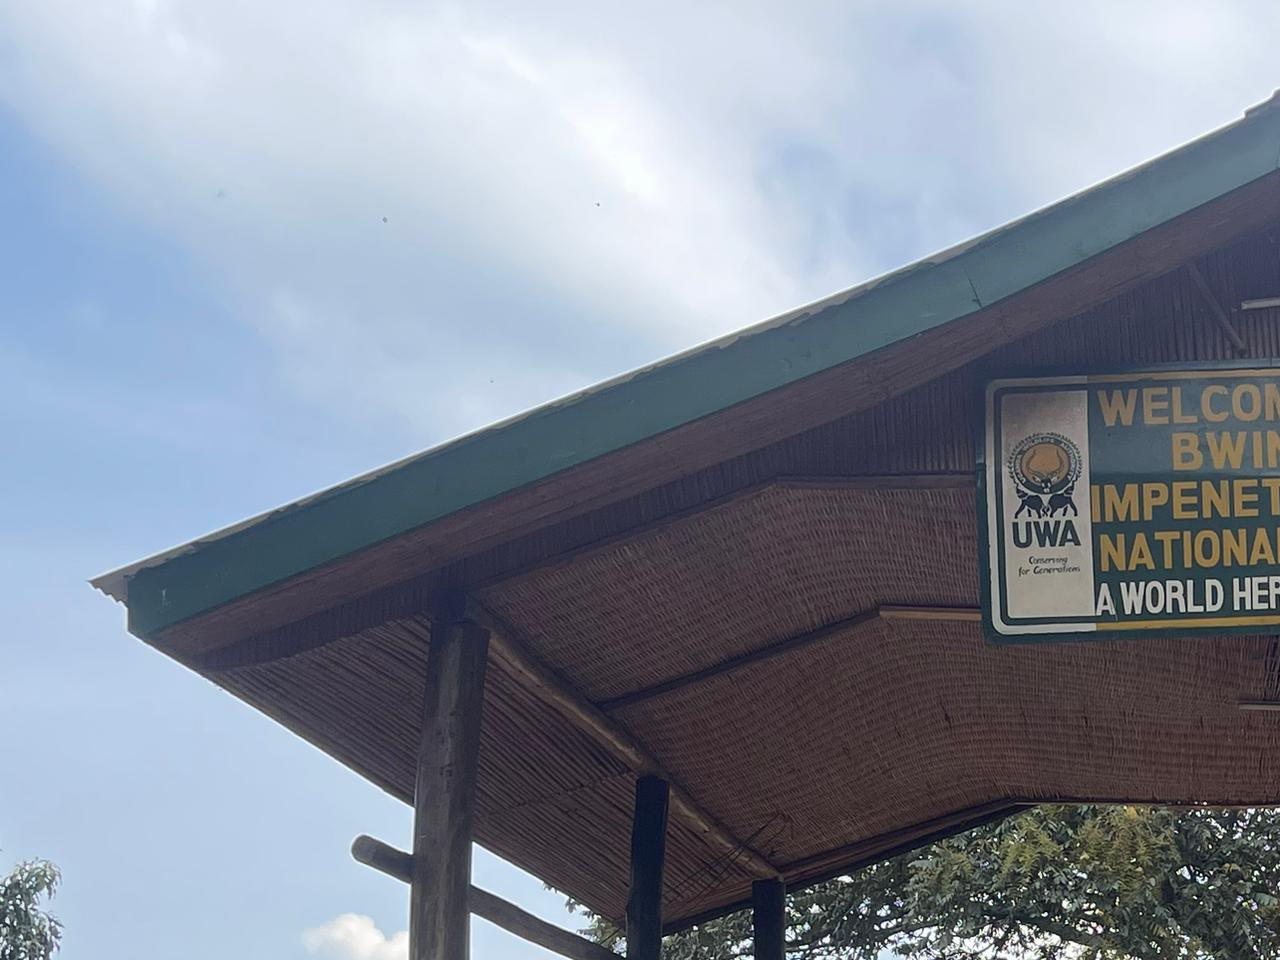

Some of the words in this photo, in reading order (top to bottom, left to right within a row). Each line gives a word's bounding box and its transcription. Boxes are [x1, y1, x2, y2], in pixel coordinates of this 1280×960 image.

[1012, 519, 1082, 549] UWA
[1018, 566, 1030, 577] for
[1096, 580, 1116, 617] A
[1119, 577, 1223, 617] WORLD
